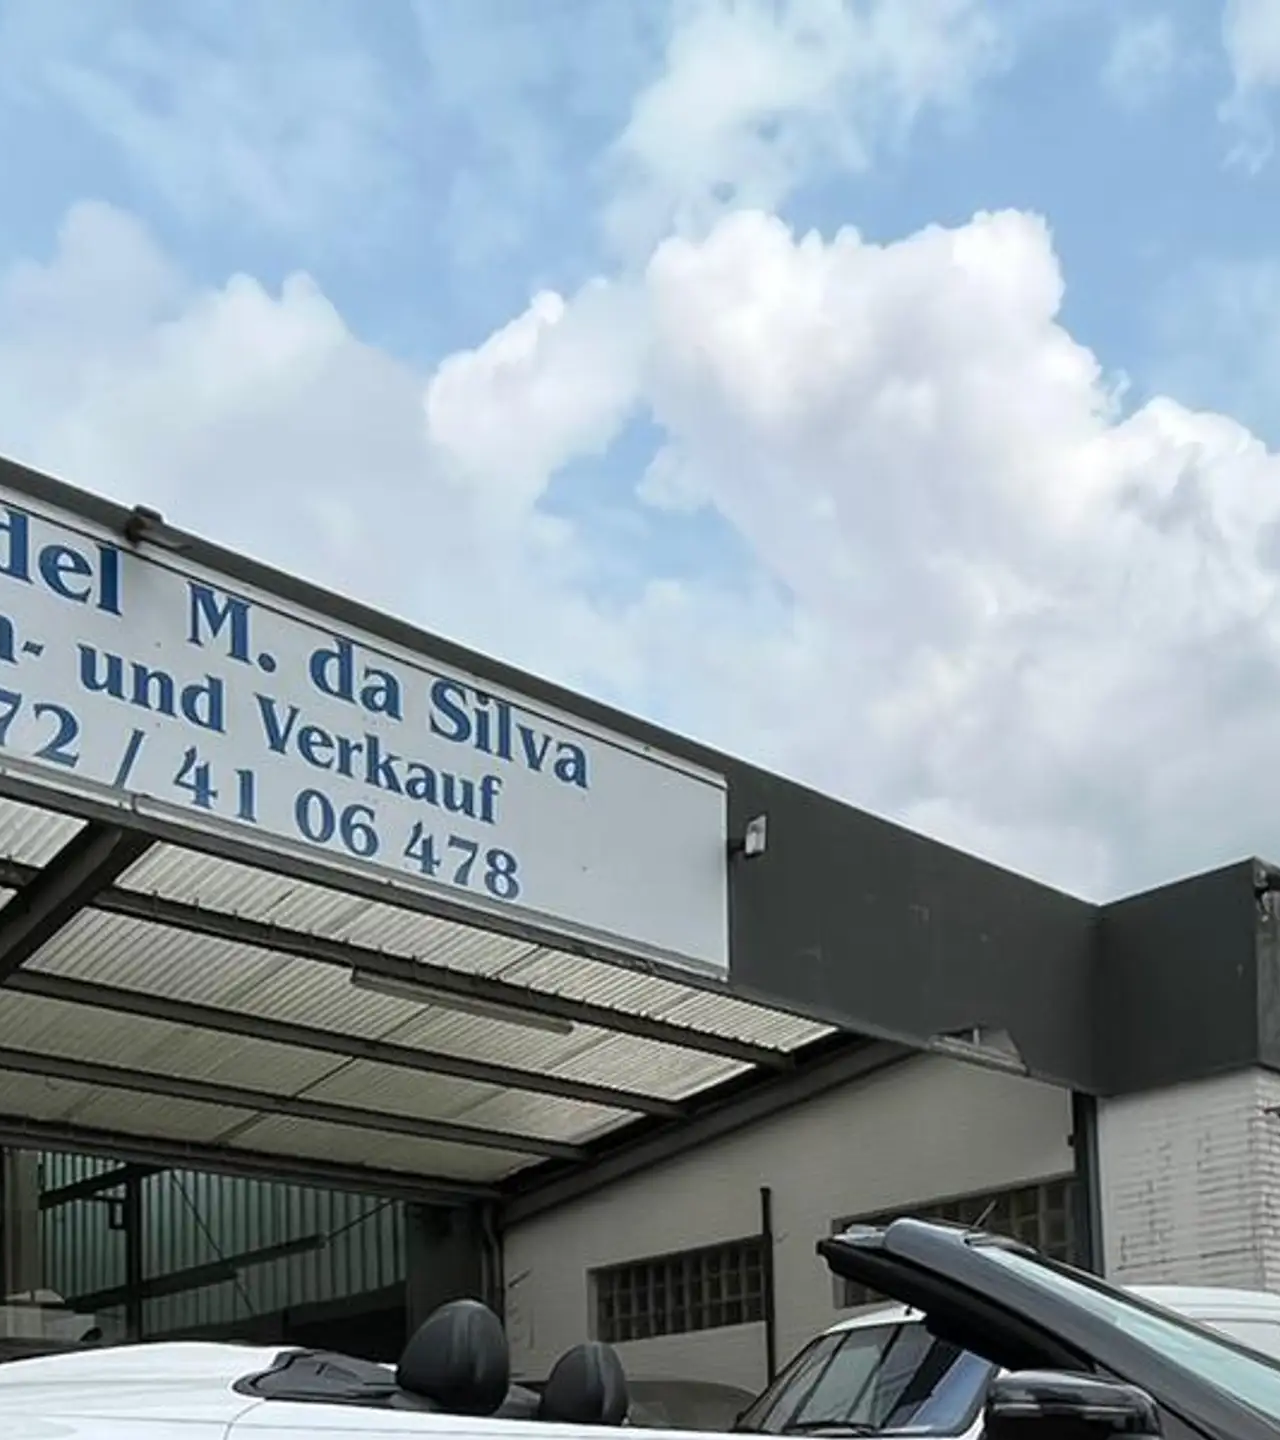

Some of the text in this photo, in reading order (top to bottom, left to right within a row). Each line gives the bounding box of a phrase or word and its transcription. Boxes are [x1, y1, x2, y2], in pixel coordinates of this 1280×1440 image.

[78, 644, 225, 734] und
[254, 693, 503, 824] Verkauf
[187, 582, 277, 673] M.
[309, 635, 402, 721] da
[429, 678, 589, 788] Silva
[112, 730, 145, 789] /
[174, 748, 257, 823] 41
[295, 788, 380, 857] 06
[404, 821, 521, 900] 478
